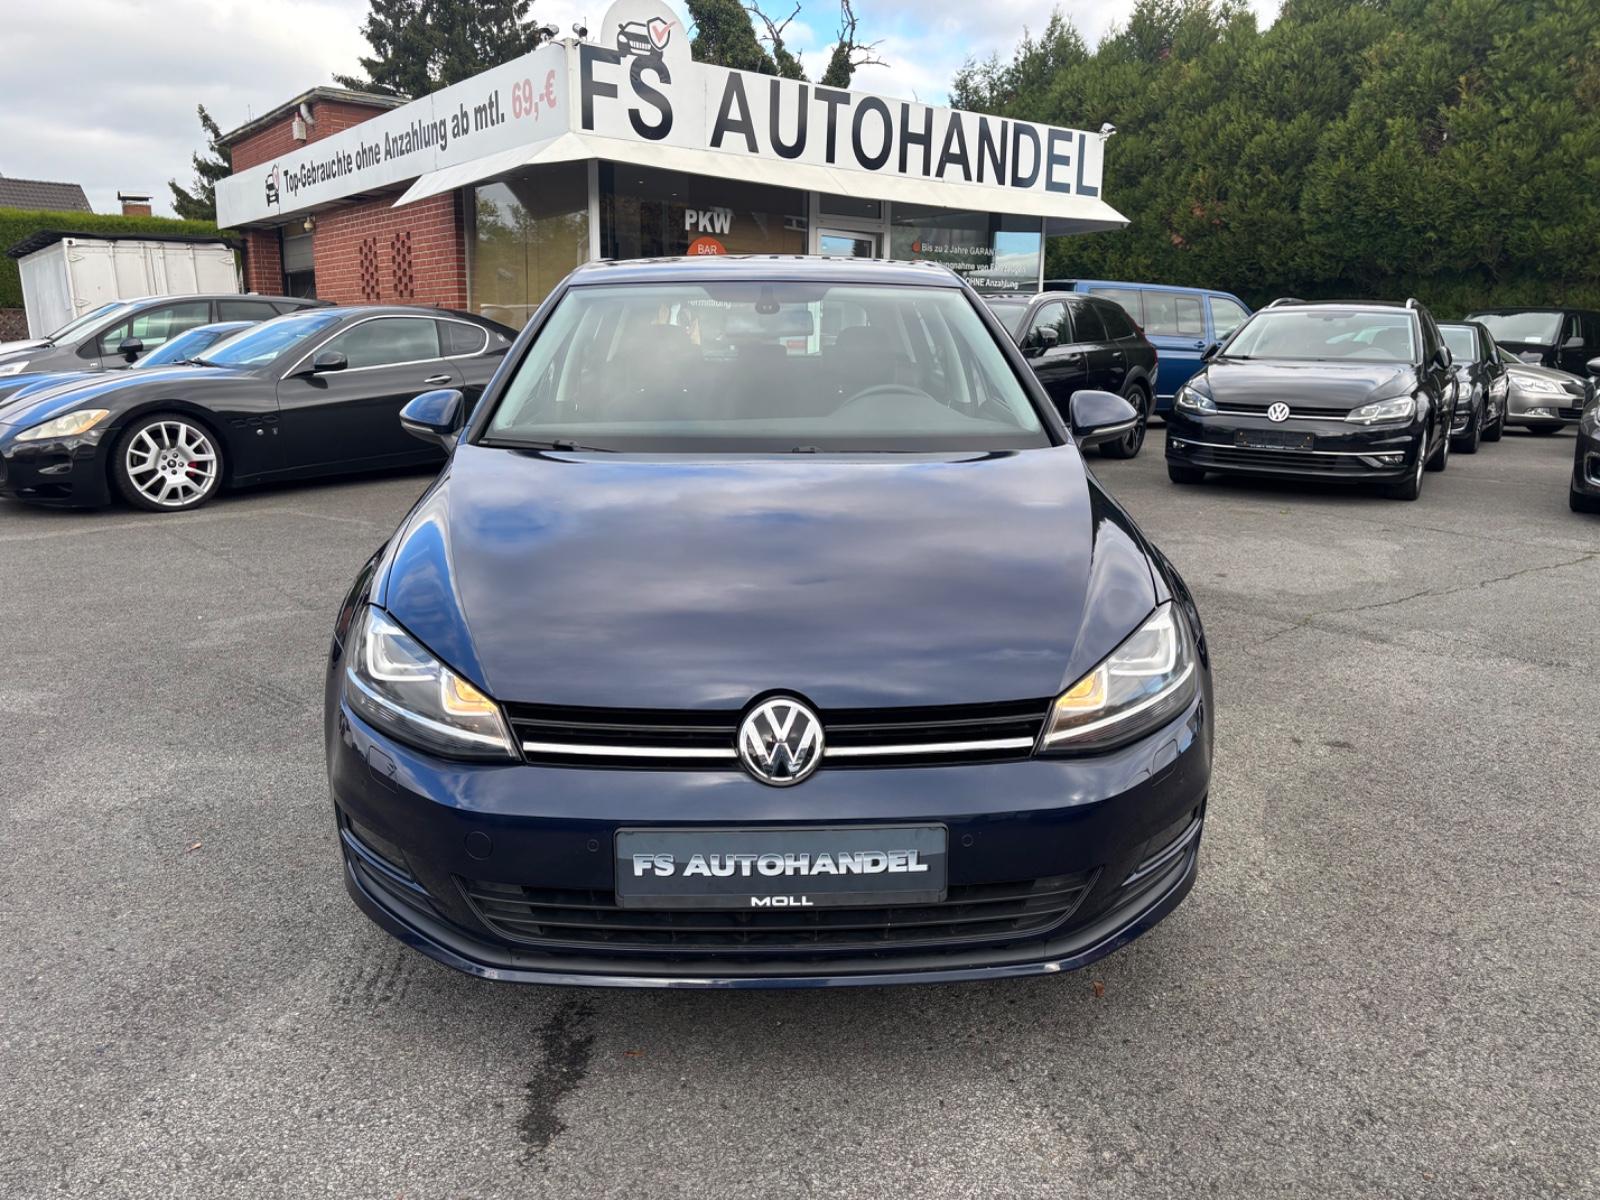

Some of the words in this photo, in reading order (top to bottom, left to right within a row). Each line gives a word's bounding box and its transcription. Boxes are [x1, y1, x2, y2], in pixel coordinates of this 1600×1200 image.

[580, 43, 673, 141] FS
[709, 71, 1099, 197] AUTOHANDEL
[283, 149, 352, 197] Top-Gebrauchte
[355, 141, 381, 171] ohne
[384, 117, 448, 161] Anzahlung
[452, 103, 469, 139] ab
[474, 90, 505, 131] mtl.
[511, 69, 557, 121] 69,-€
[685, 209, 731, 235] PKW
[697, 243, 717, 255] BAR
[921, 243, 932, 253] Bis
[934, 245, 943, 253] zu
[944, 245, 949, 253] 2
[950, 245, 968, 255] Jahre
[965, 277, 985, 287] OHNE
[986, 278, 1018, 291] Anzahlung
[632, 853, 676, 878] FS
[682, 850, 929, 877] AUTOHANDEL
[750, 896, 814, 908] MOLL
